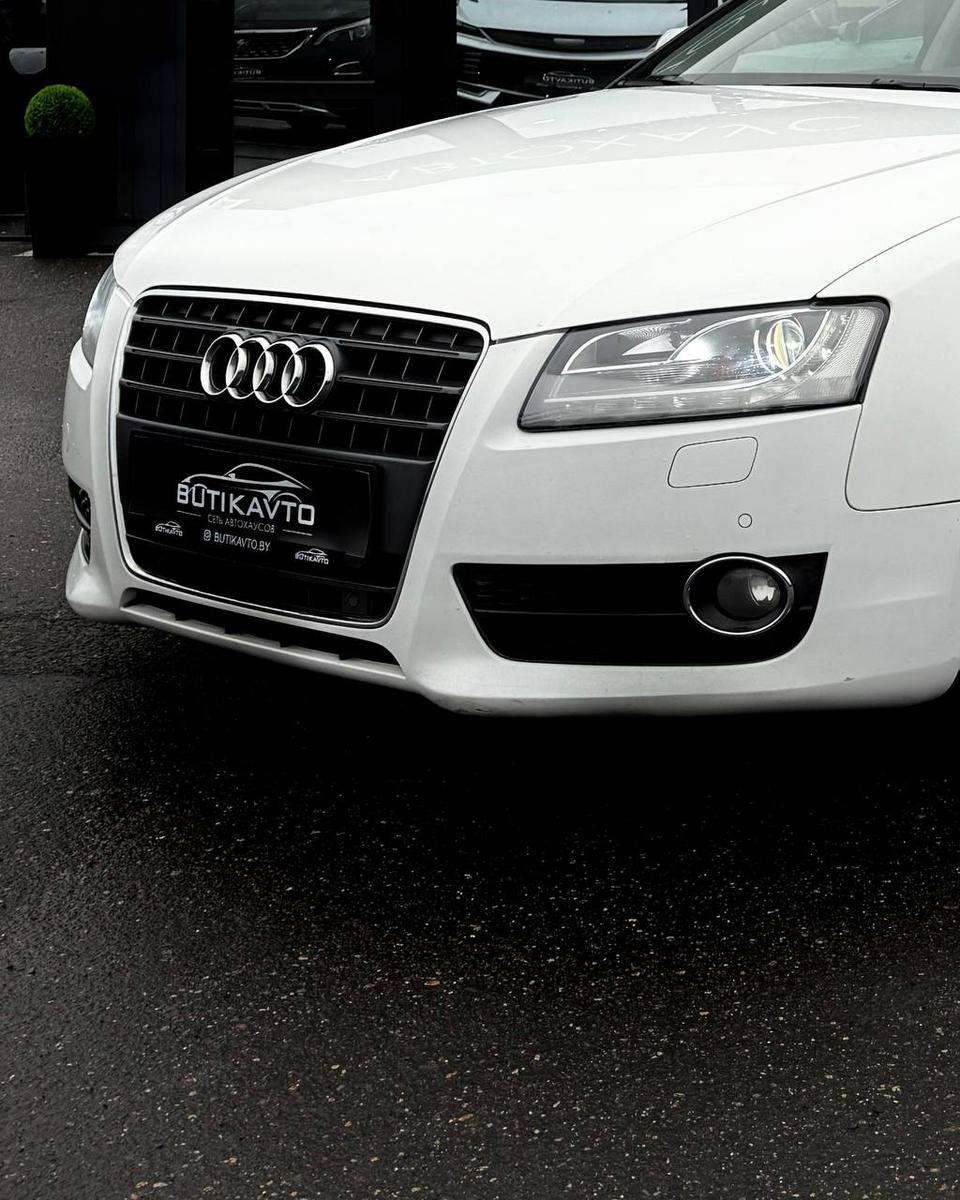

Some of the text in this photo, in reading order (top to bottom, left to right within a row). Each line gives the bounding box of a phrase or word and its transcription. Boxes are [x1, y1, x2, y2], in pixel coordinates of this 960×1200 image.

[177, 482, 315, 526] BUTIKAVTO
[225, 518, 275, 533] АВТОХАУСОВ
[214, 531, 271, 552] BUTIKAVTO.BY
